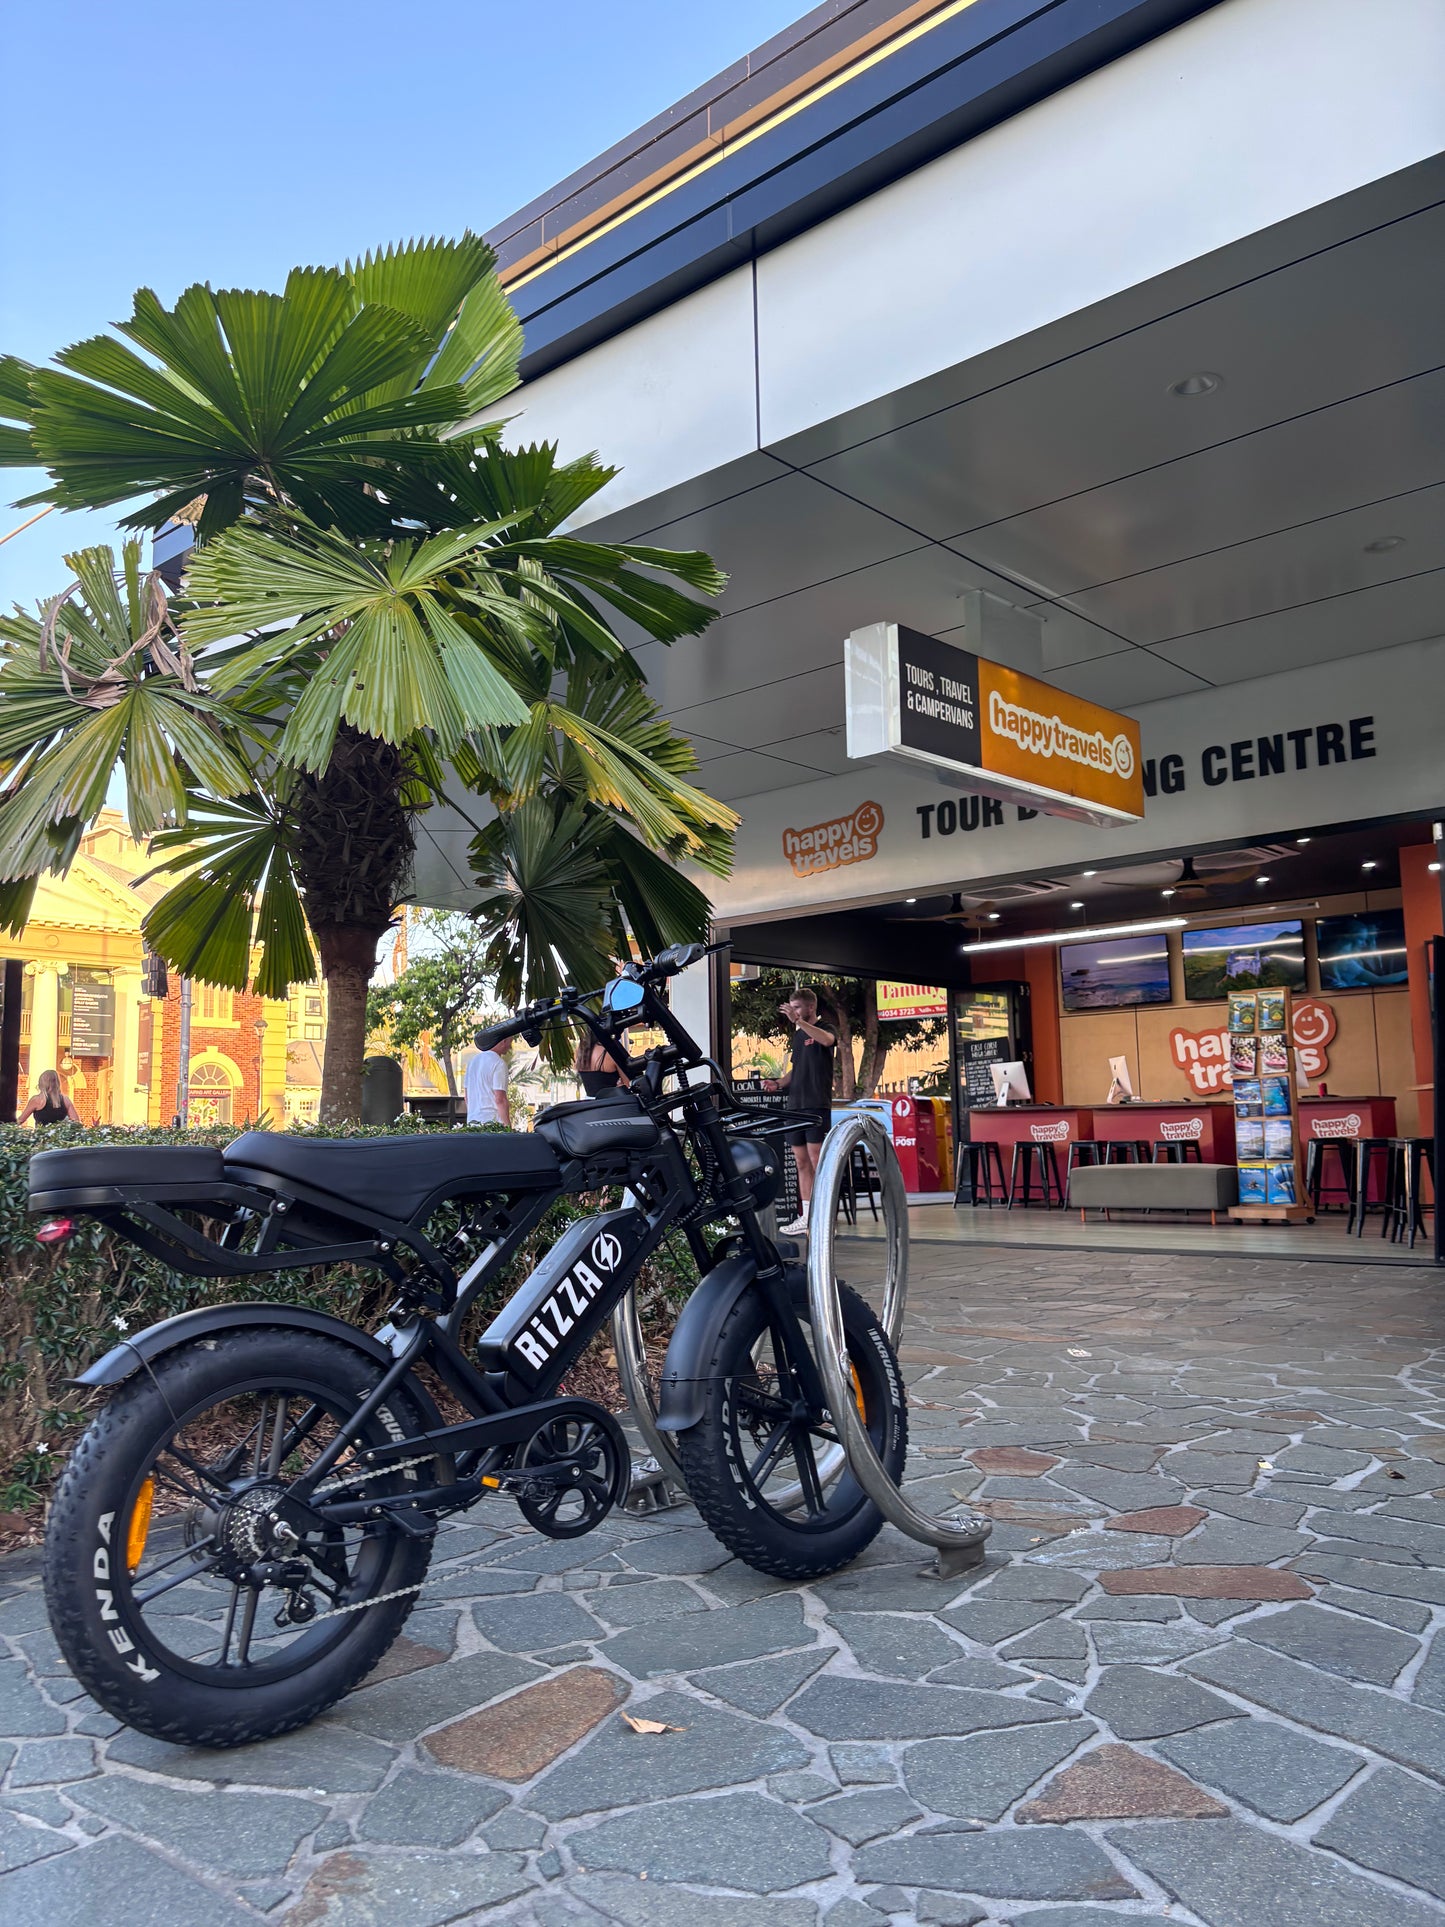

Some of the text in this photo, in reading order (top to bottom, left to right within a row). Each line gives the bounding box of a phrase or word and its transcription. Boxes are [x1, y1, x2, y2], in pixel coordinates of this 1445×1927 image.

[940, 676, 973, 705] TRAVEL
[907, 690, 973, 730] & CAMPERVANS
[916, 794, 1004, 839] TOUR
[1202, 716, 1377, 786] CENTRE
[786, 819, 854, 855] happy
[794, 836, 873, 873] travels
[1032, 1126, 1059, 1134] happy
[1036, 1131, 1066, 1140] travels
[1162, 1122, 1191, 1133] happy
[1166, 1129, 1199, 1139] travels
[1314, 1120, 1348, 1129] happy
[1319, 1126, 1356, 1137] travels
[895, 1137, 917, 1147] POST
[874, 1340, 902, 1409] KRUSADE
[721, 1377, 757, 1510] KENDA
[93, 1511, 161, 1684] KENDA
